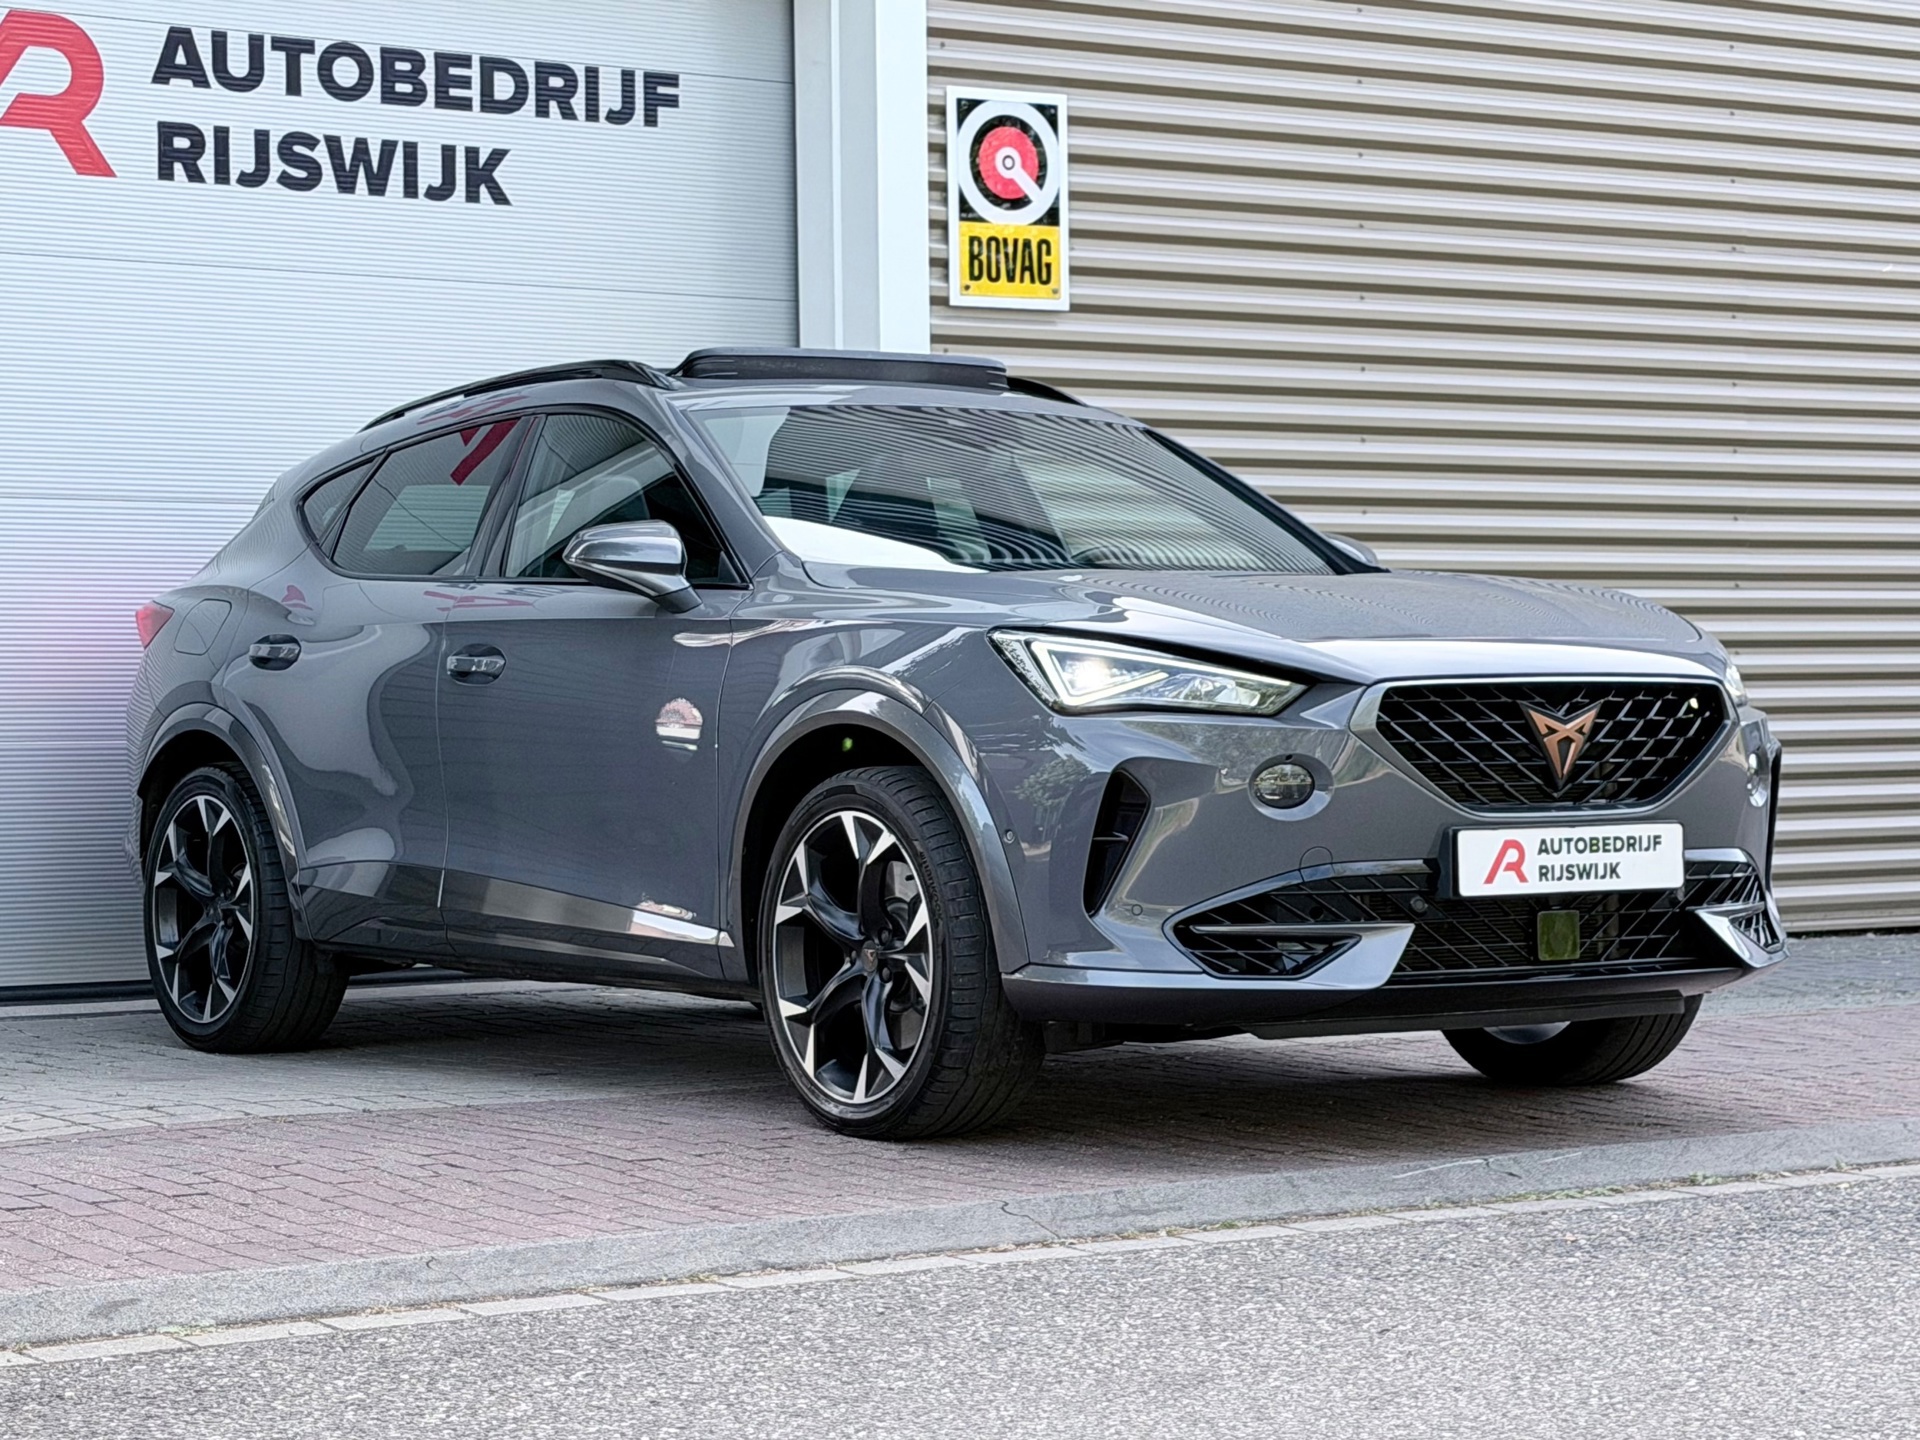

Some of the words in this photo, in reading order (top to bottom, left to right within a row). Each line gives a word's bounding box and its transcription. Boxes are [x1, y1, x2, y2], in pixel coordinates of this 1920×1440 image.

[151, 26, 680, 127] AUTOBEDRIJF
[157, 121, 512, 206] RIJSWIJK
[968, 236, 1052, 285] BOVAG
[1537, 835, 1662, 855] AUTOBEDRIJF
[1538, 862, 1621, 882] RIJSWIJK
